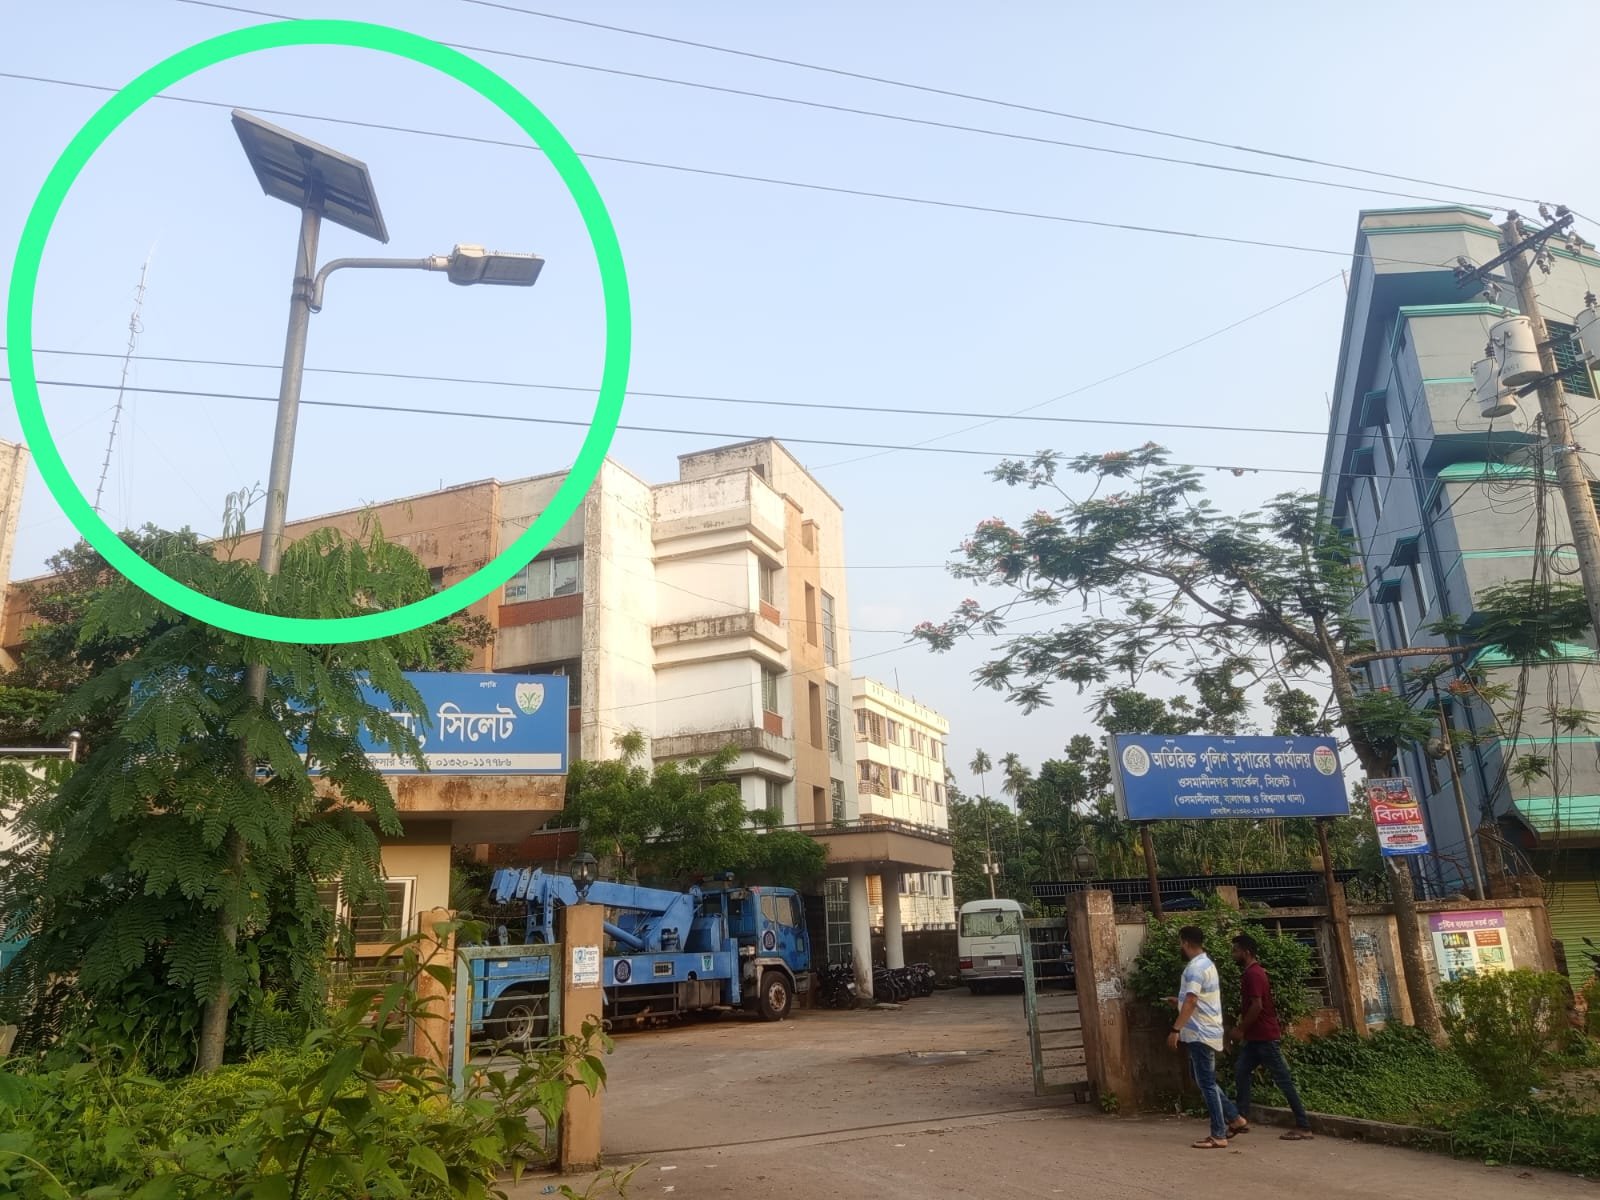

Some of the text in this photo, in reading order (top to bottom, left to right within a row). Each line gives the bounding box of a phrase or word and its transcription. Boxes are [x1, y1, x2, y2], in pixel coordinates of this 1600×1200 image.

[436, 702, 517, 744] সিলেট
[1150, 746, 1312, 773] অতিরিক্ত পুলিশ সুপারের কার্যালয়
[1178, 774, 1229, 789] ওসমানীনগর
[1264, 774, 1290, 788] সিলেট
[1373, 805, 1420, 823] বিলাস
